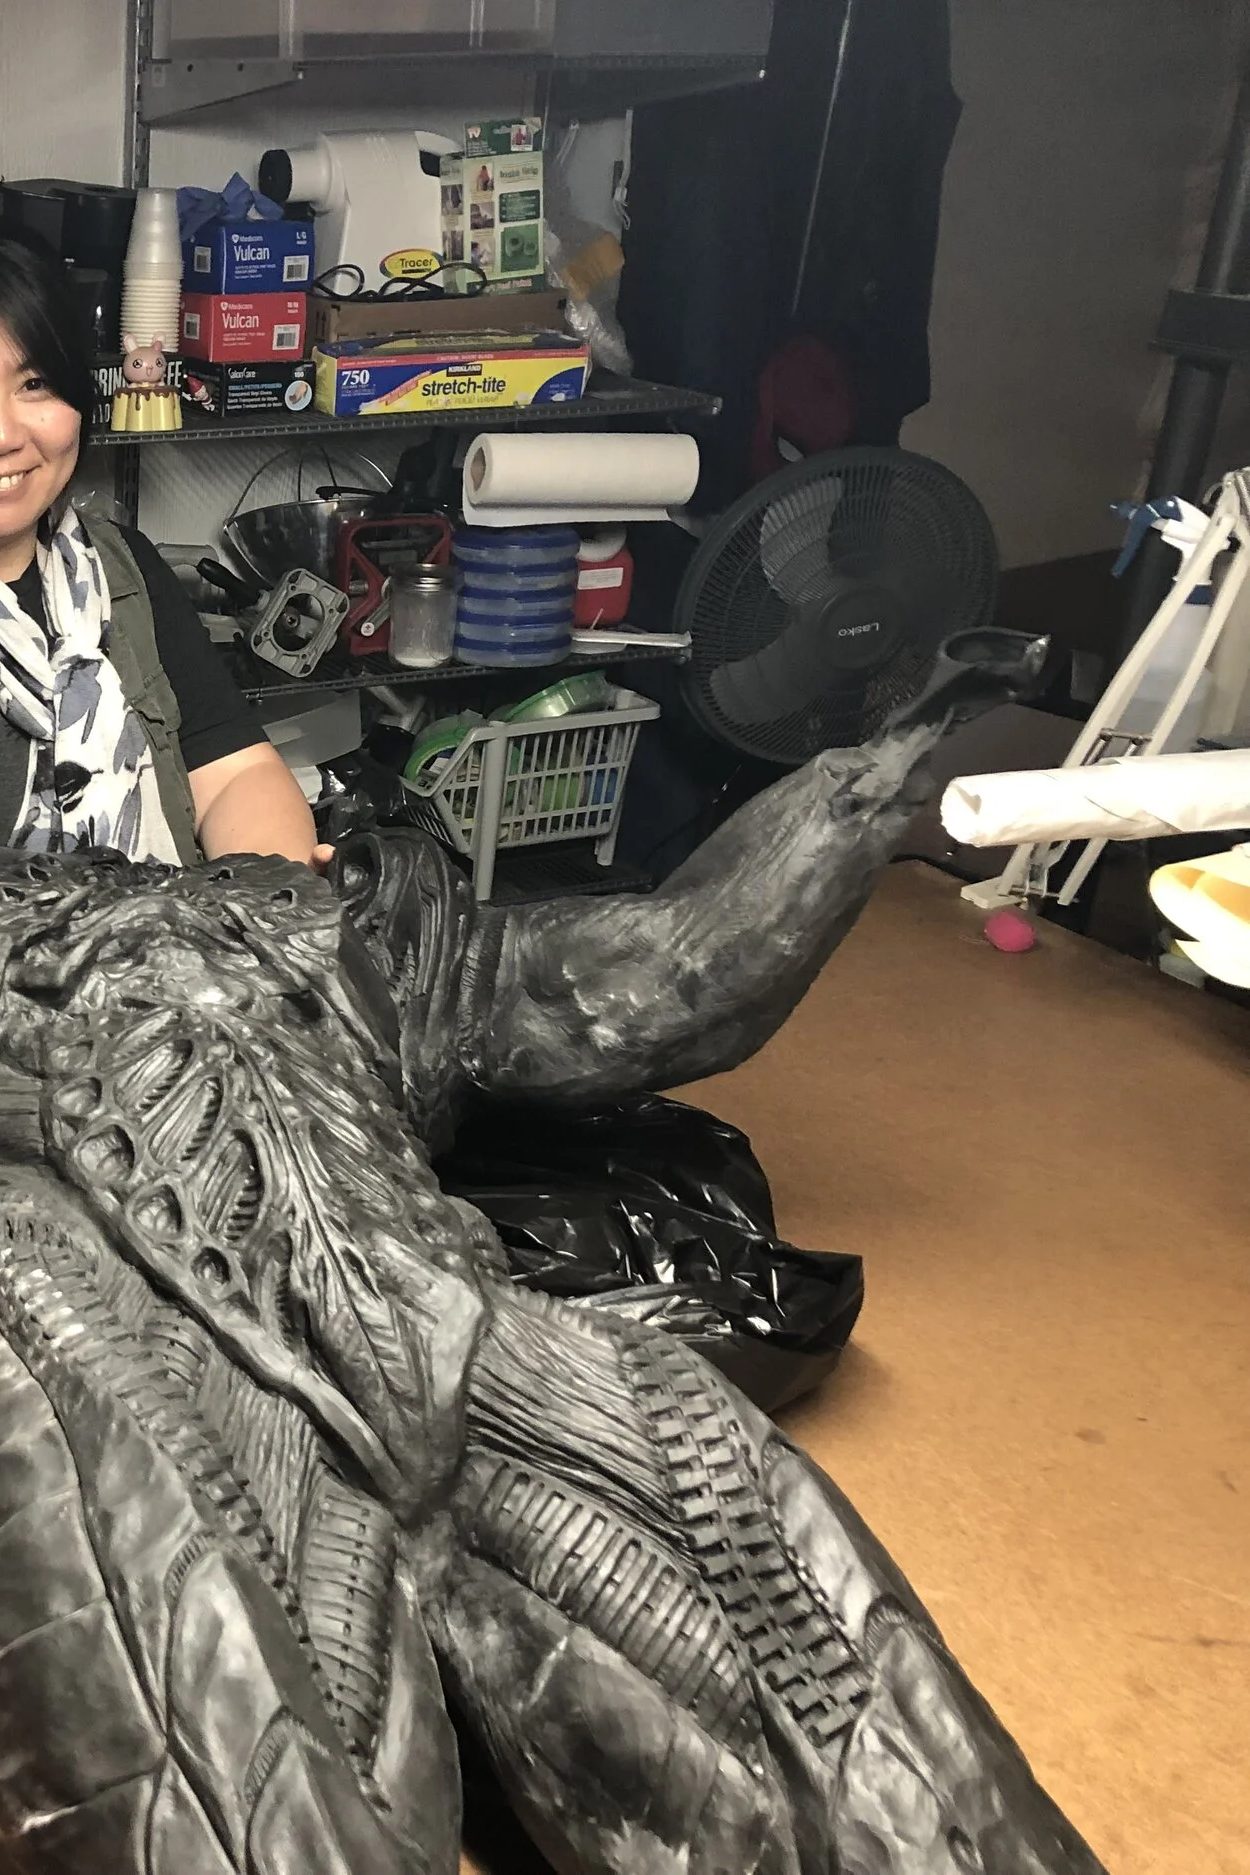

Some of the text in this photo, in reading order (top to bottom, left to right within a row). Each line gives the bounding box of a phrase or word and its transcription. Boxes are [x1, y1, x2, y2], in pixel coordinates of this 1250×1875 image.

[233, 244, 270, 262] Vulcan
[400, 258, 433, 268] Tracer
[222, 312, 260, 329] Vulcan
[341, 369, 370, 386] 750
[448, 365, 481, 373] KIRKLAND
[421, 376, 507, 397] stretch-tite
[838, 622, 879, 637] Lasko
